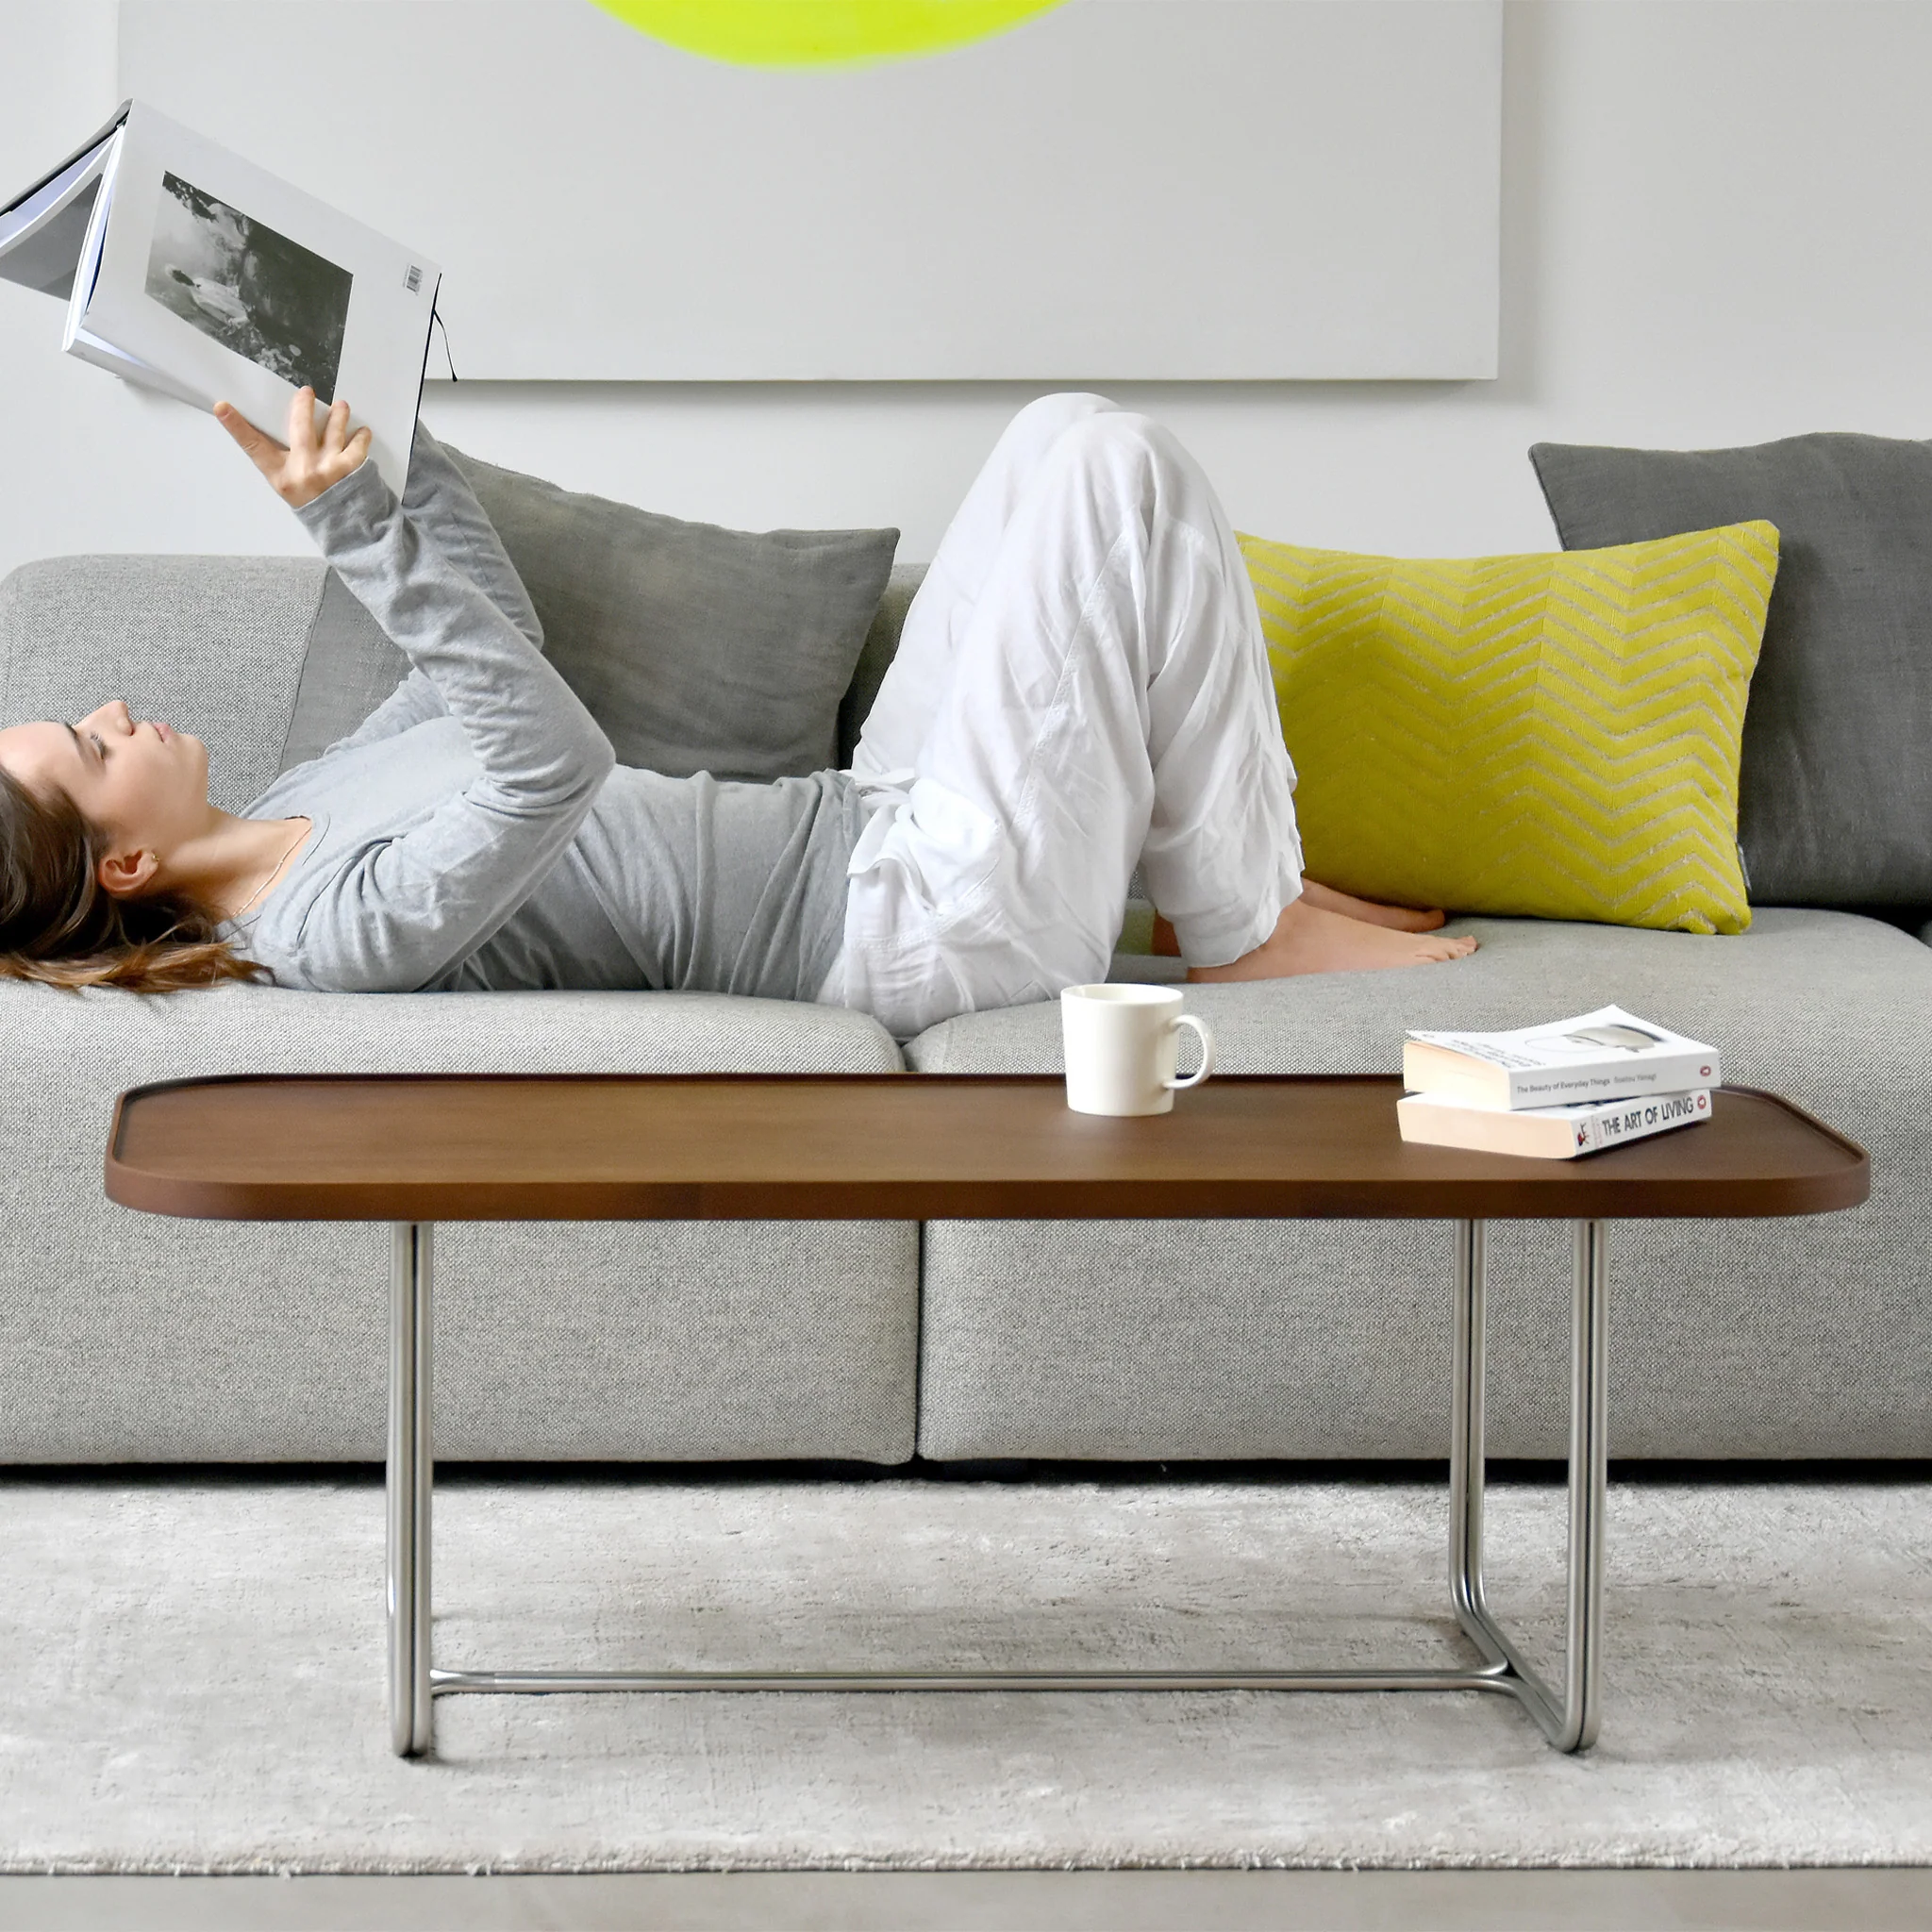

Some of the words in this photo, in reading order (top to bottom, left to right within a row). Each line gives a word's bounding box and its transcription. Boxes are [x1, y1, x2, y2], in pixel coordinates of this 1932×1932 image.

[1591, 1078, 1610, 1087] Things
[1602, 1117, 1621, 1136] THE
[1624, 1111, 1641, 1131] ART
[1645, 1107, 1658, 1124] OF
[1660, 1097, 1694, 1121] LIVING
